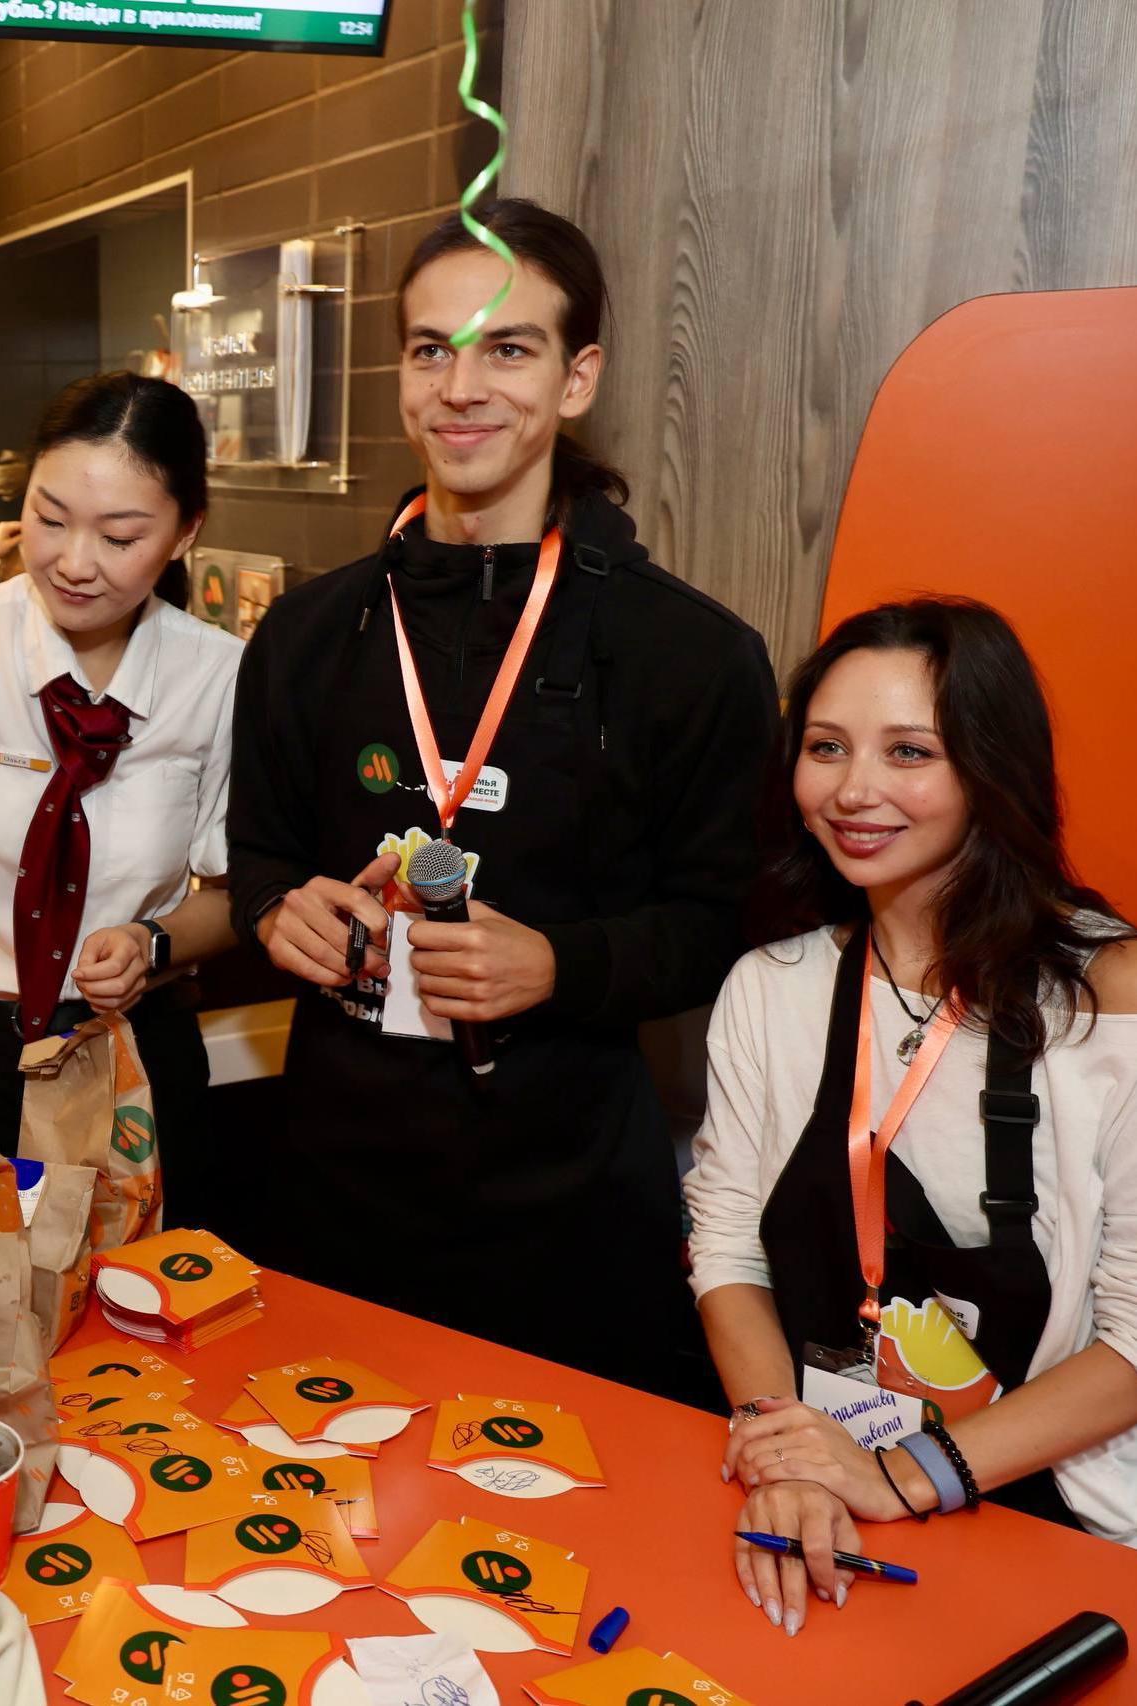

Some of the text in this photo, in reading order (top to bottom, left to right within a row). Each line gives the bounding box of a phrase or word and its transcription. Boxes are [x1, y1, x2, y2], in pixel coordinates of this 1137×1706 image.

[58, 1, 121, 26] Найди
[123, 9, 137, 24] в
[139, 10, 262, 31] приложении!
[474, 779, 497, 787] МЬЯ
[470, 788, 500, 797] МЕСТЕ
